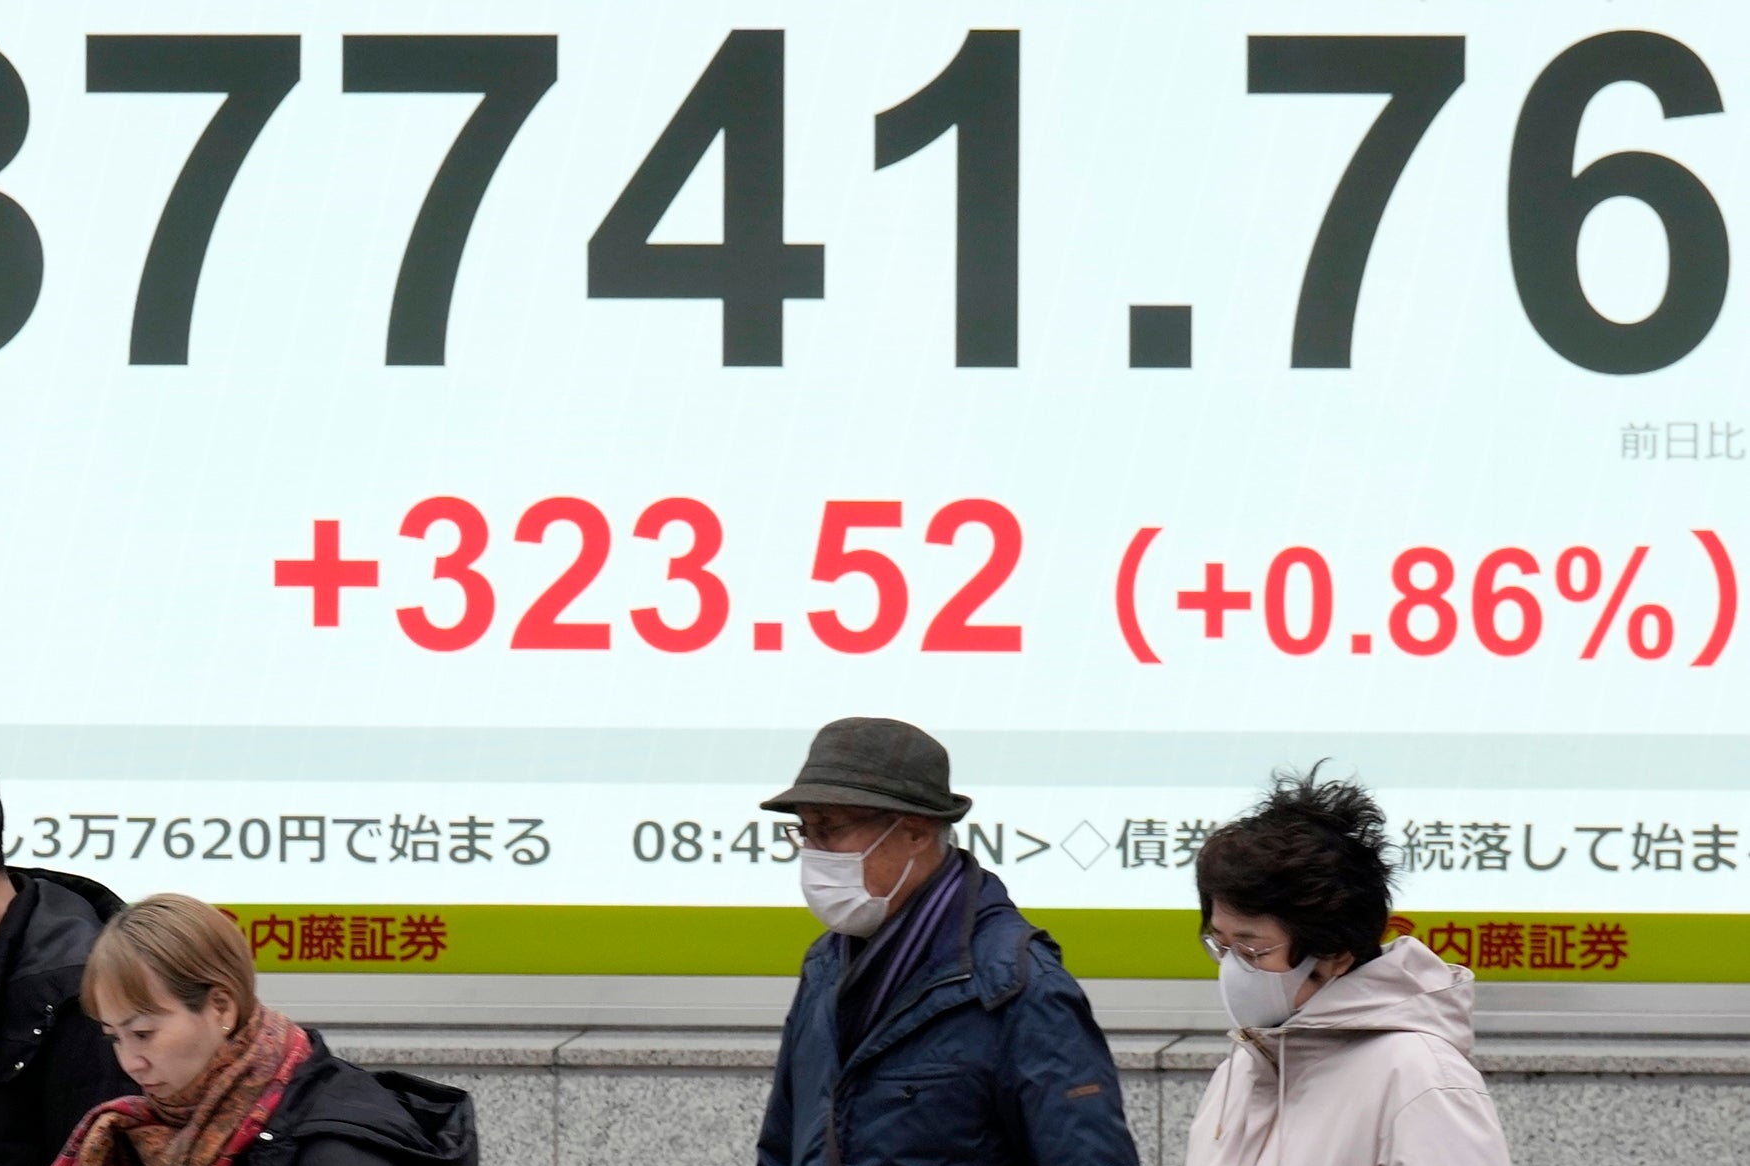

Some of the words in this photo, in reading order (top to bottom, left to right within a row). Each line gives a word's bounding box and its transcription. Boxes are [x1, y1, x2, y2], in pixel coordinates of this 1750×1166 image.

[1620, 421, 1746, 460] 前日比
[274, 496, 1023, 655] +323.52
[1115, 527, 1738, 667] (+0.86%)
[251, 913, 448, 963] 内藤証券
[1427, 921, 1629, 970] 内藤証券
